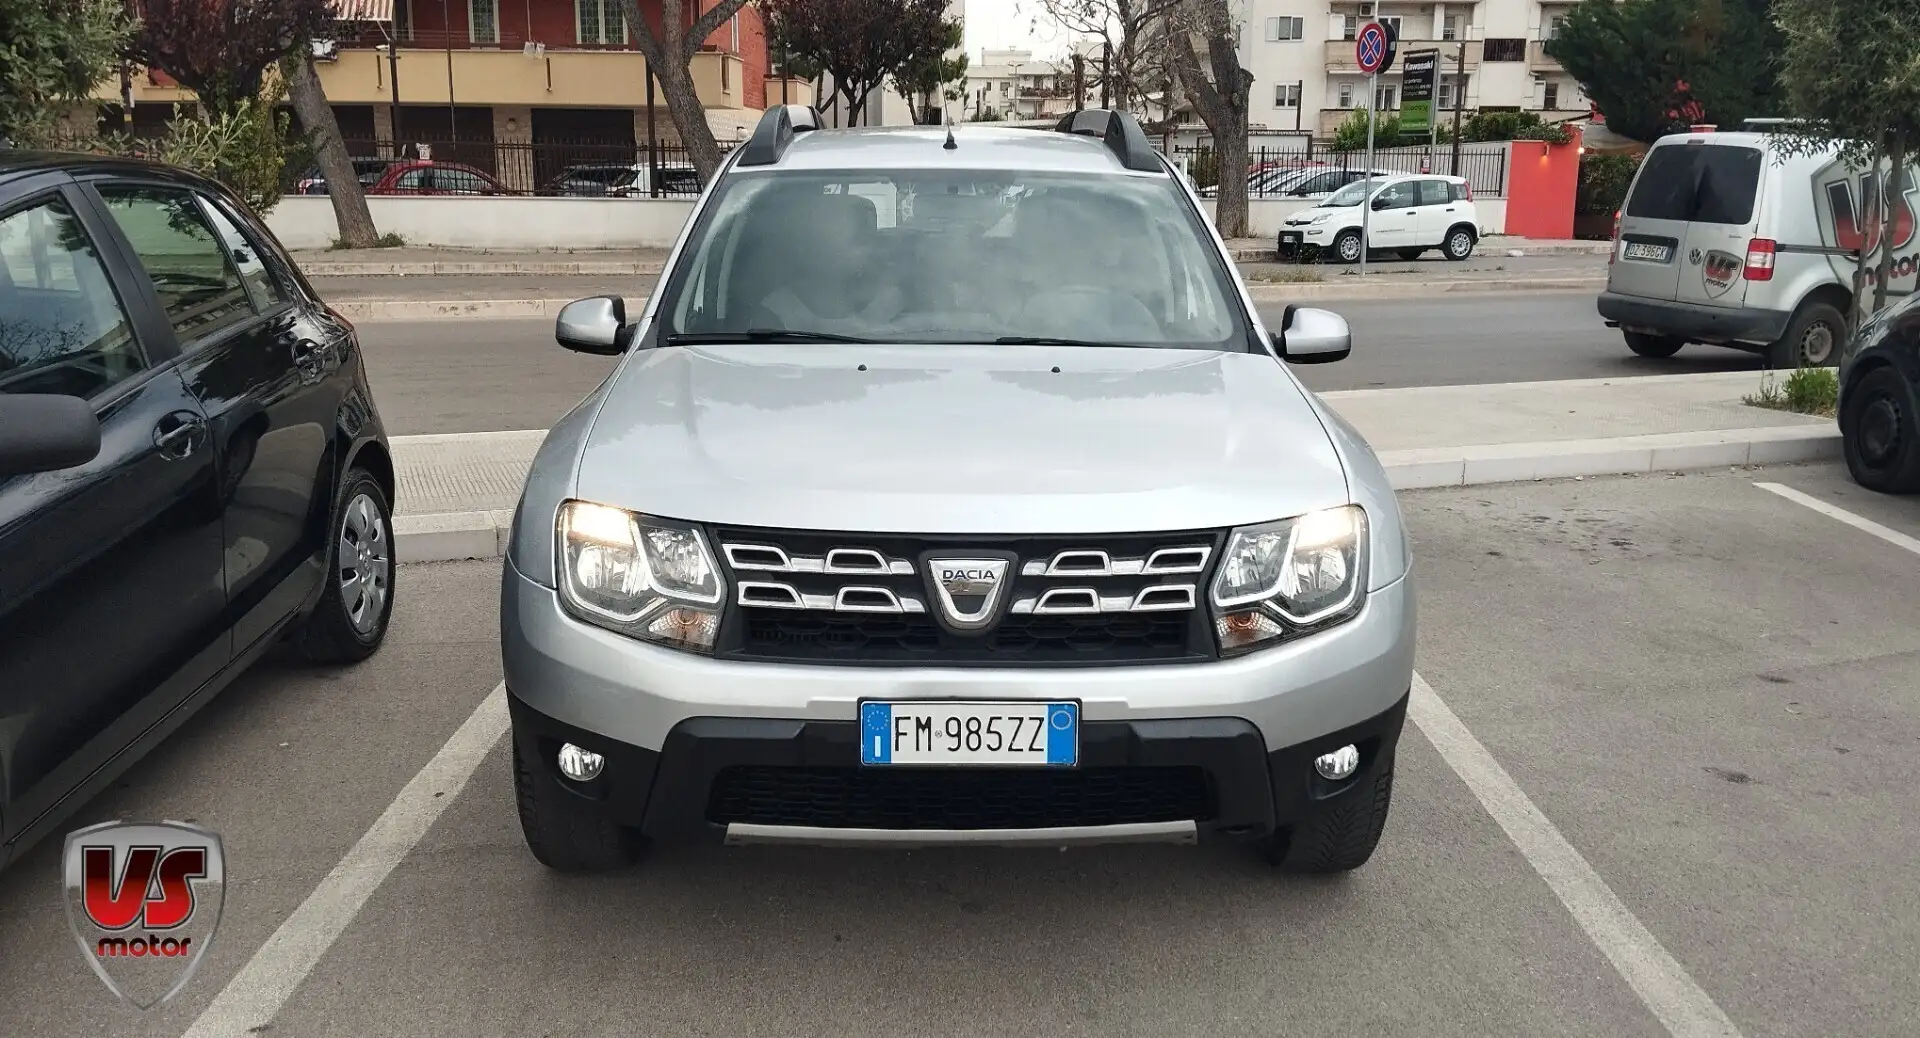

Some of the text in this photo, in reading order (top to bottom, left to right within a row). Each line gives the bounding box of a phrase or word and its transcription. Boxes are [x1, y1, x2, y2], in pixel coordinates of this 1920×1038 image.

[1706, 277, 1728, 289] motor
[942, 569, 995, 580] DACIA
[894, 716, 1045, 752] FM 985ZZ
